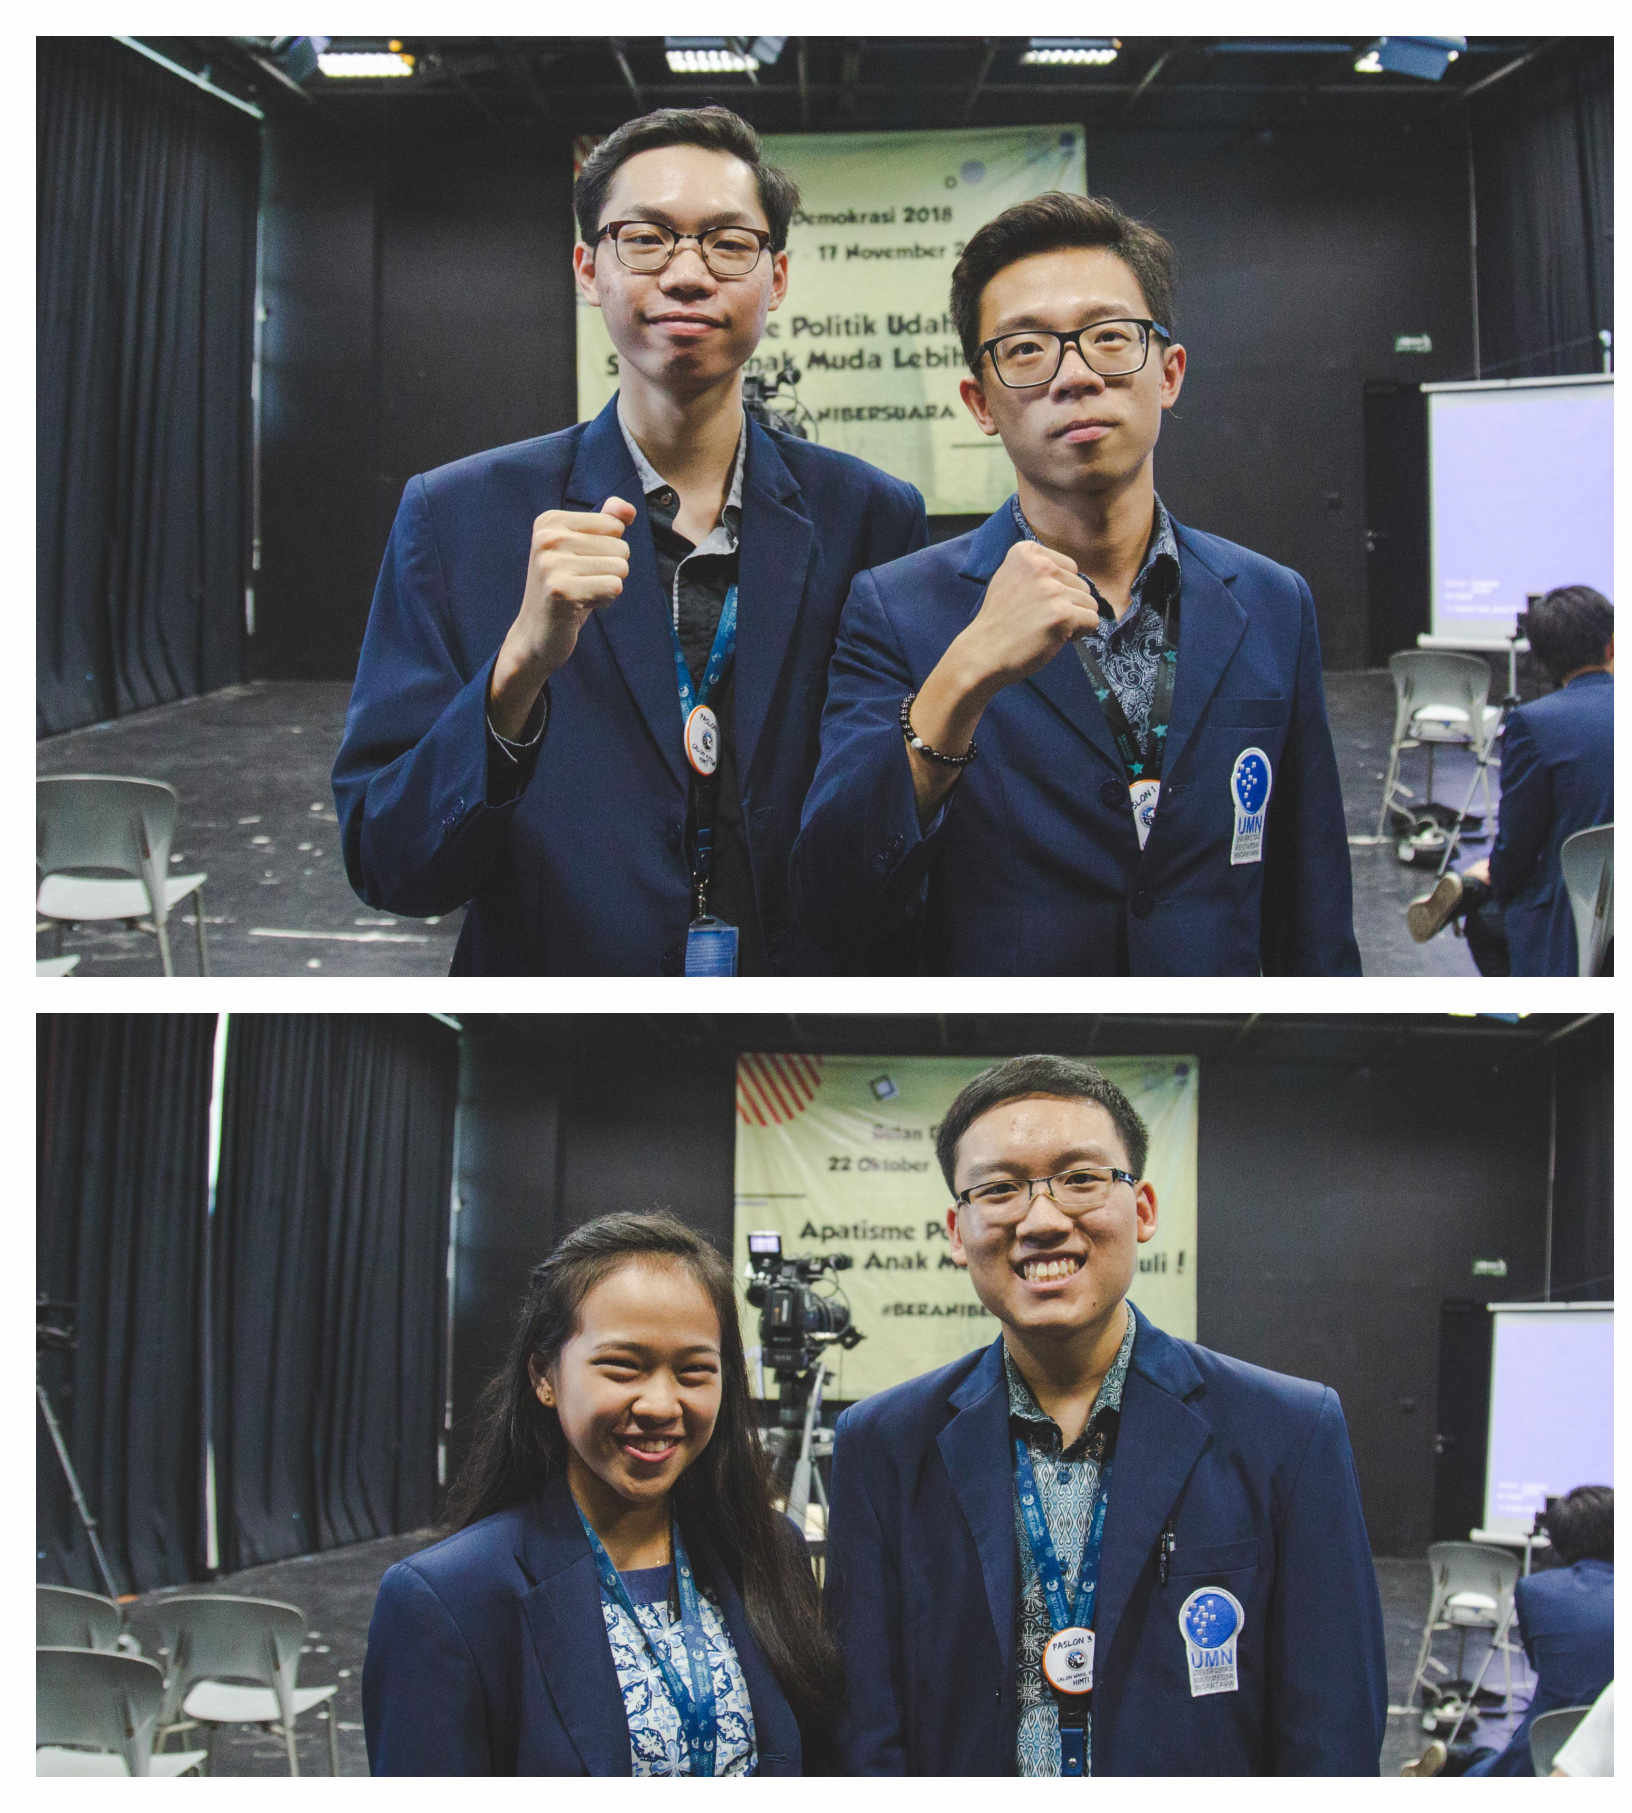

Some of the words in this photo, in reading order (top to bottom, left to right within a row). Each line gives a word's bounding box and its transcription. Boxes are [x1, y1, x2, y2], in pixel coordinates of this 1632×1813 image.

[902, 205, 953, 224] 2018
[819, 243, 838, 262] 17
[846, 241, 946, 261] November
[791, 314, 876, 338] Politik
[807, 348, 881, 371] Muda
[1131, 789, 1152, 810] SLON
[1238, 815, 1263, 835] UMN
[828, 1155, 851, 1172] 22
[800, 1220, 915, 1244] Apatisme
[864, 1251, 927, 1270] Anak
[1140, 1253, 1167, 1273] uli
[1052, 1637, 1085, 1651] PASLON
[1087, 1635, 1093, 1643] 3
[1191, 1648, 1233, 1668] UMN
[1072, 1676, 1090, 1686] HIMTI
